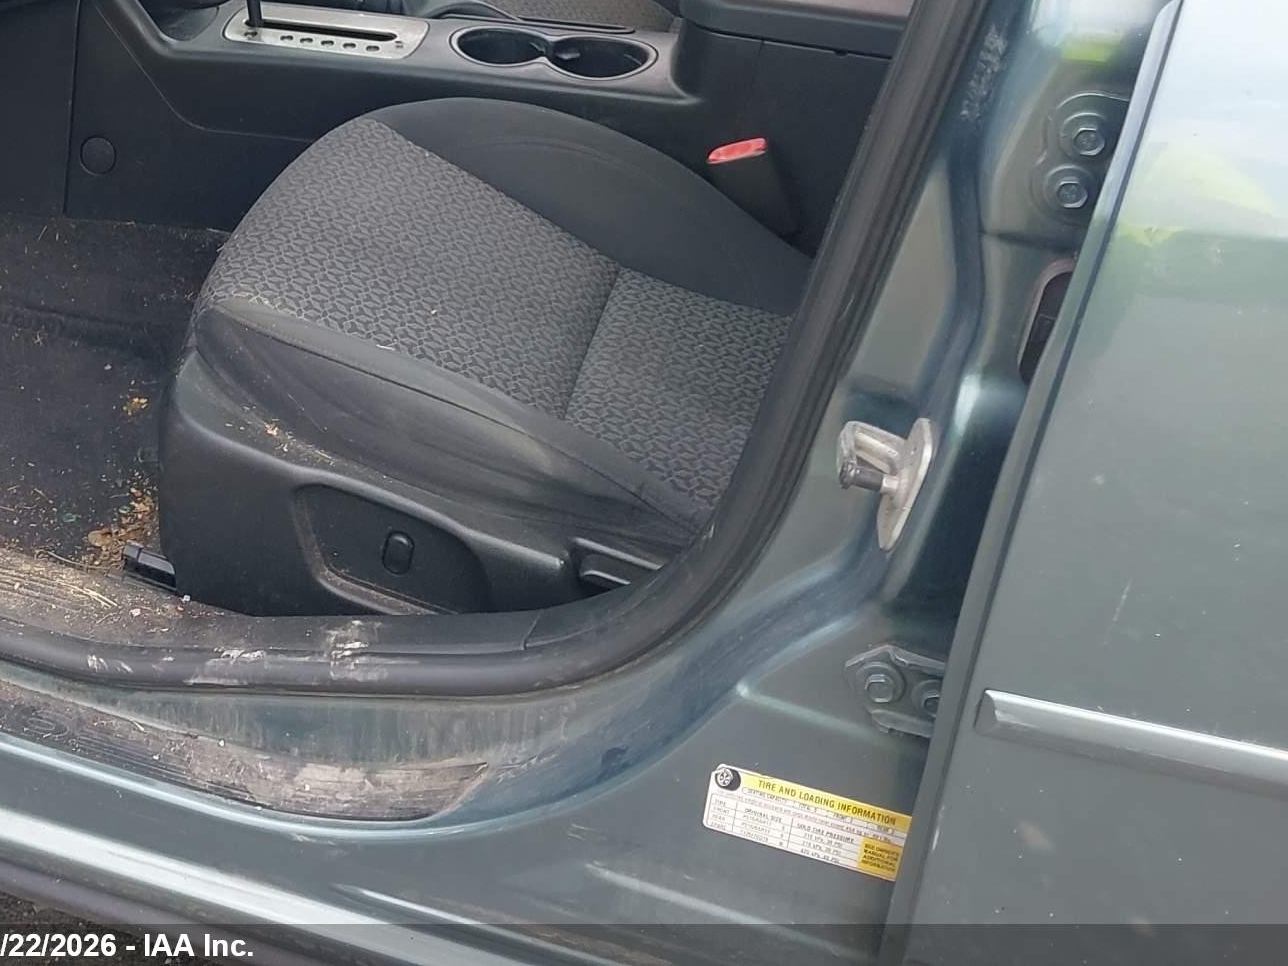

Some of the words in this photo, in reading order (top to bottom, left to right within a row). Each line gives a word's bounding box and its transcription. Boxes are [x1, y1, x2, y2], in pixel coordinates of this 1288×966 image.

[757, 780, 776, 791] TIRE
[778, 786, 796, 797] AND
[798, 792, 835, 808] LOADING
[836, 802, 897, 825] INFORMATION
